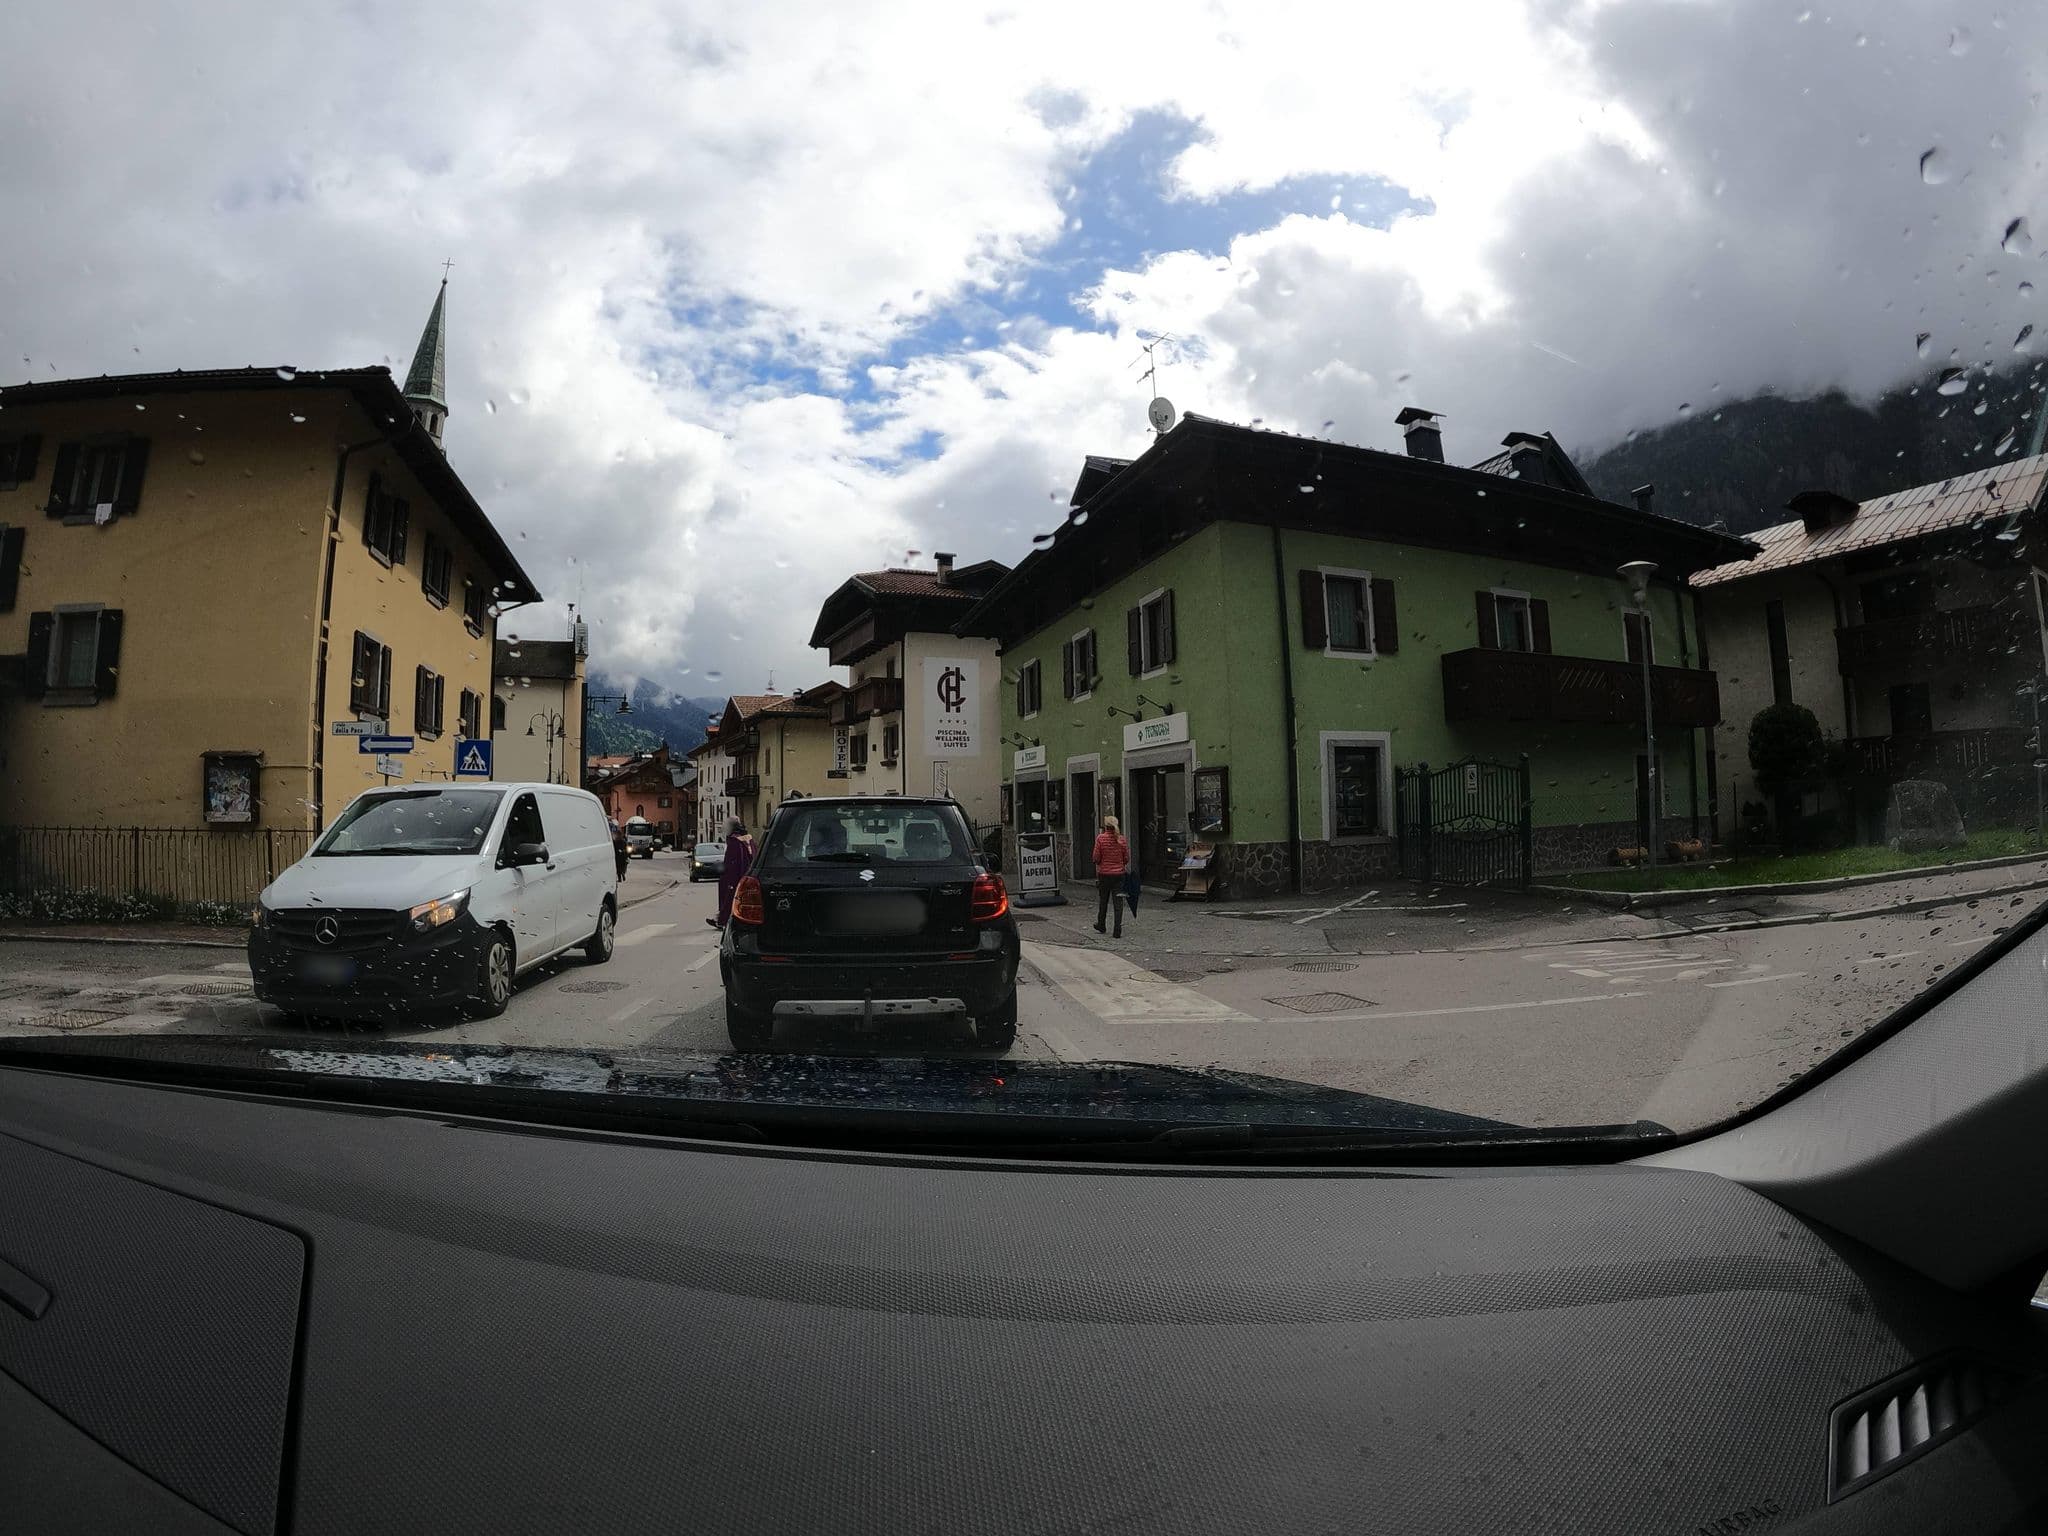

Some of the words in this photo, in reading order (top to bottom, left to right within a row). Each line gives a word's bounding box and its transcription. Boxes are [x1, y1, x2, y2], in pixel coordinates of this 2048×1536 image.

[837, 729, 847, 769] HOTEL
[1022, 854, 1053, 865] AGENZIA
[1025, 867, 1052, 877] APERTA
